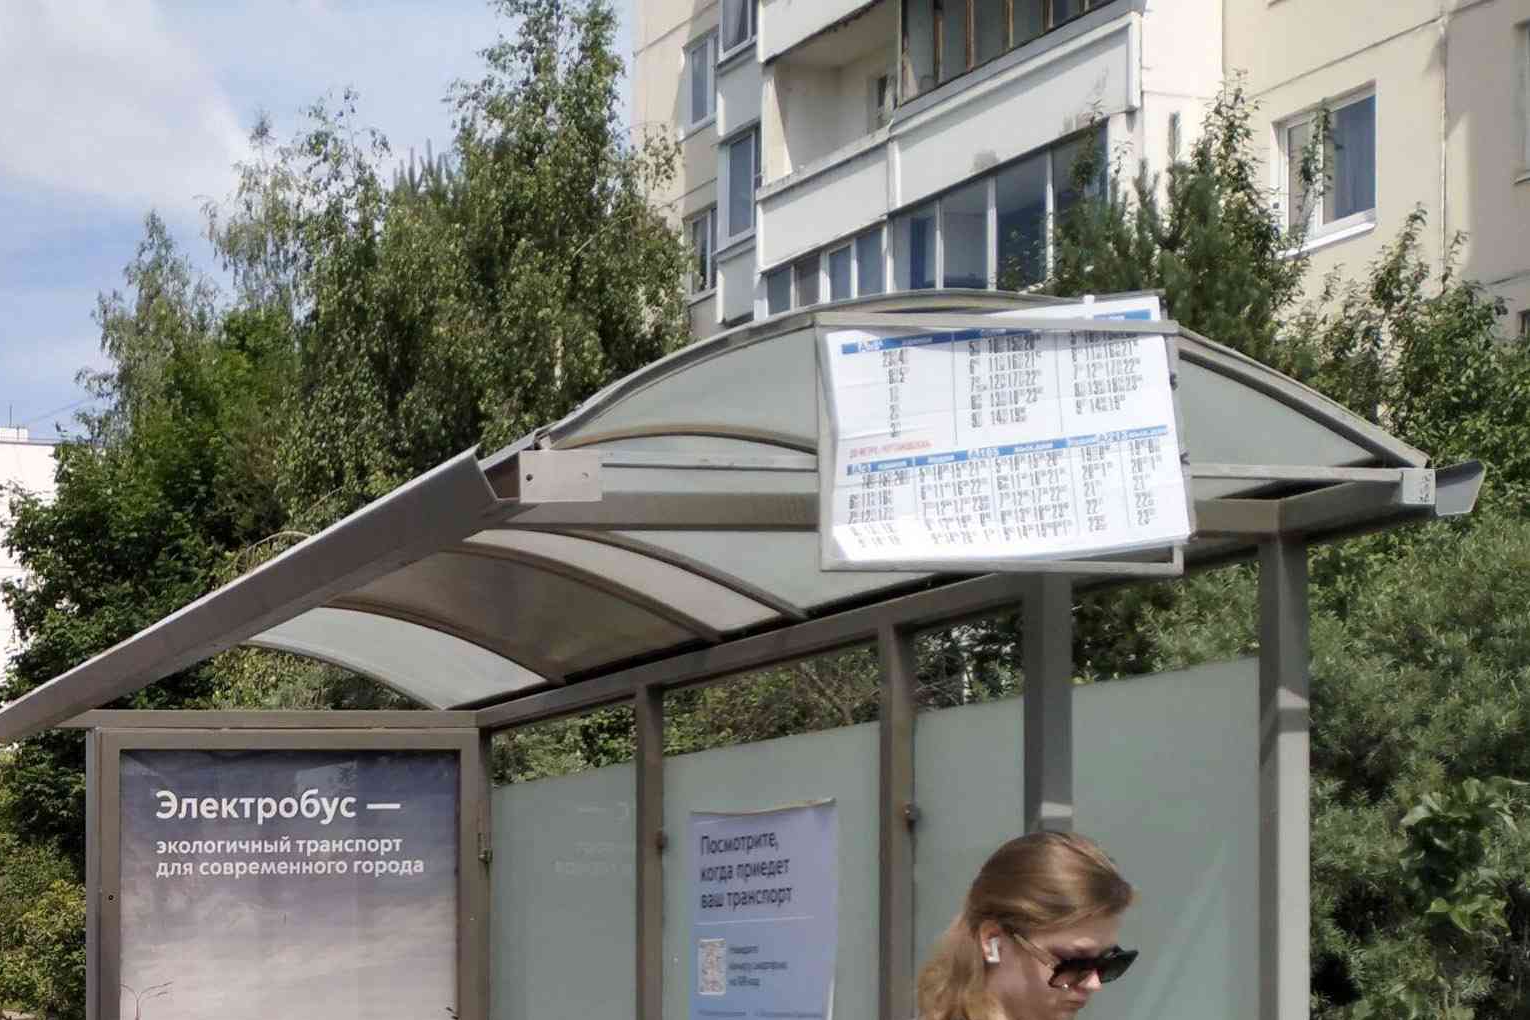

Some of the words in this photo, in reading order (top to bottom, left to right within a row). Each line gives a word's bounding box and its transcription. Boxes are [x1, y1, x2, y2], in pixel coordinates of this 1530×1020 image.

[155, 788, 357, 825] Электробус
[155, 836, 291, 854] экологичный
[296, 837, 402, 857] транспорт
[700, 832, 779, 856] Посмотрите,
[155, 860, 193, 878] для
[198, 861, 347, 879] современного
[353, 857, 425, 876] города
[700, 864, 734, 883] когда
[736, 858, 791, 884] приедет
[700, 892, 724, 909] ваш
[726, 886, 793, 912] транспорт
